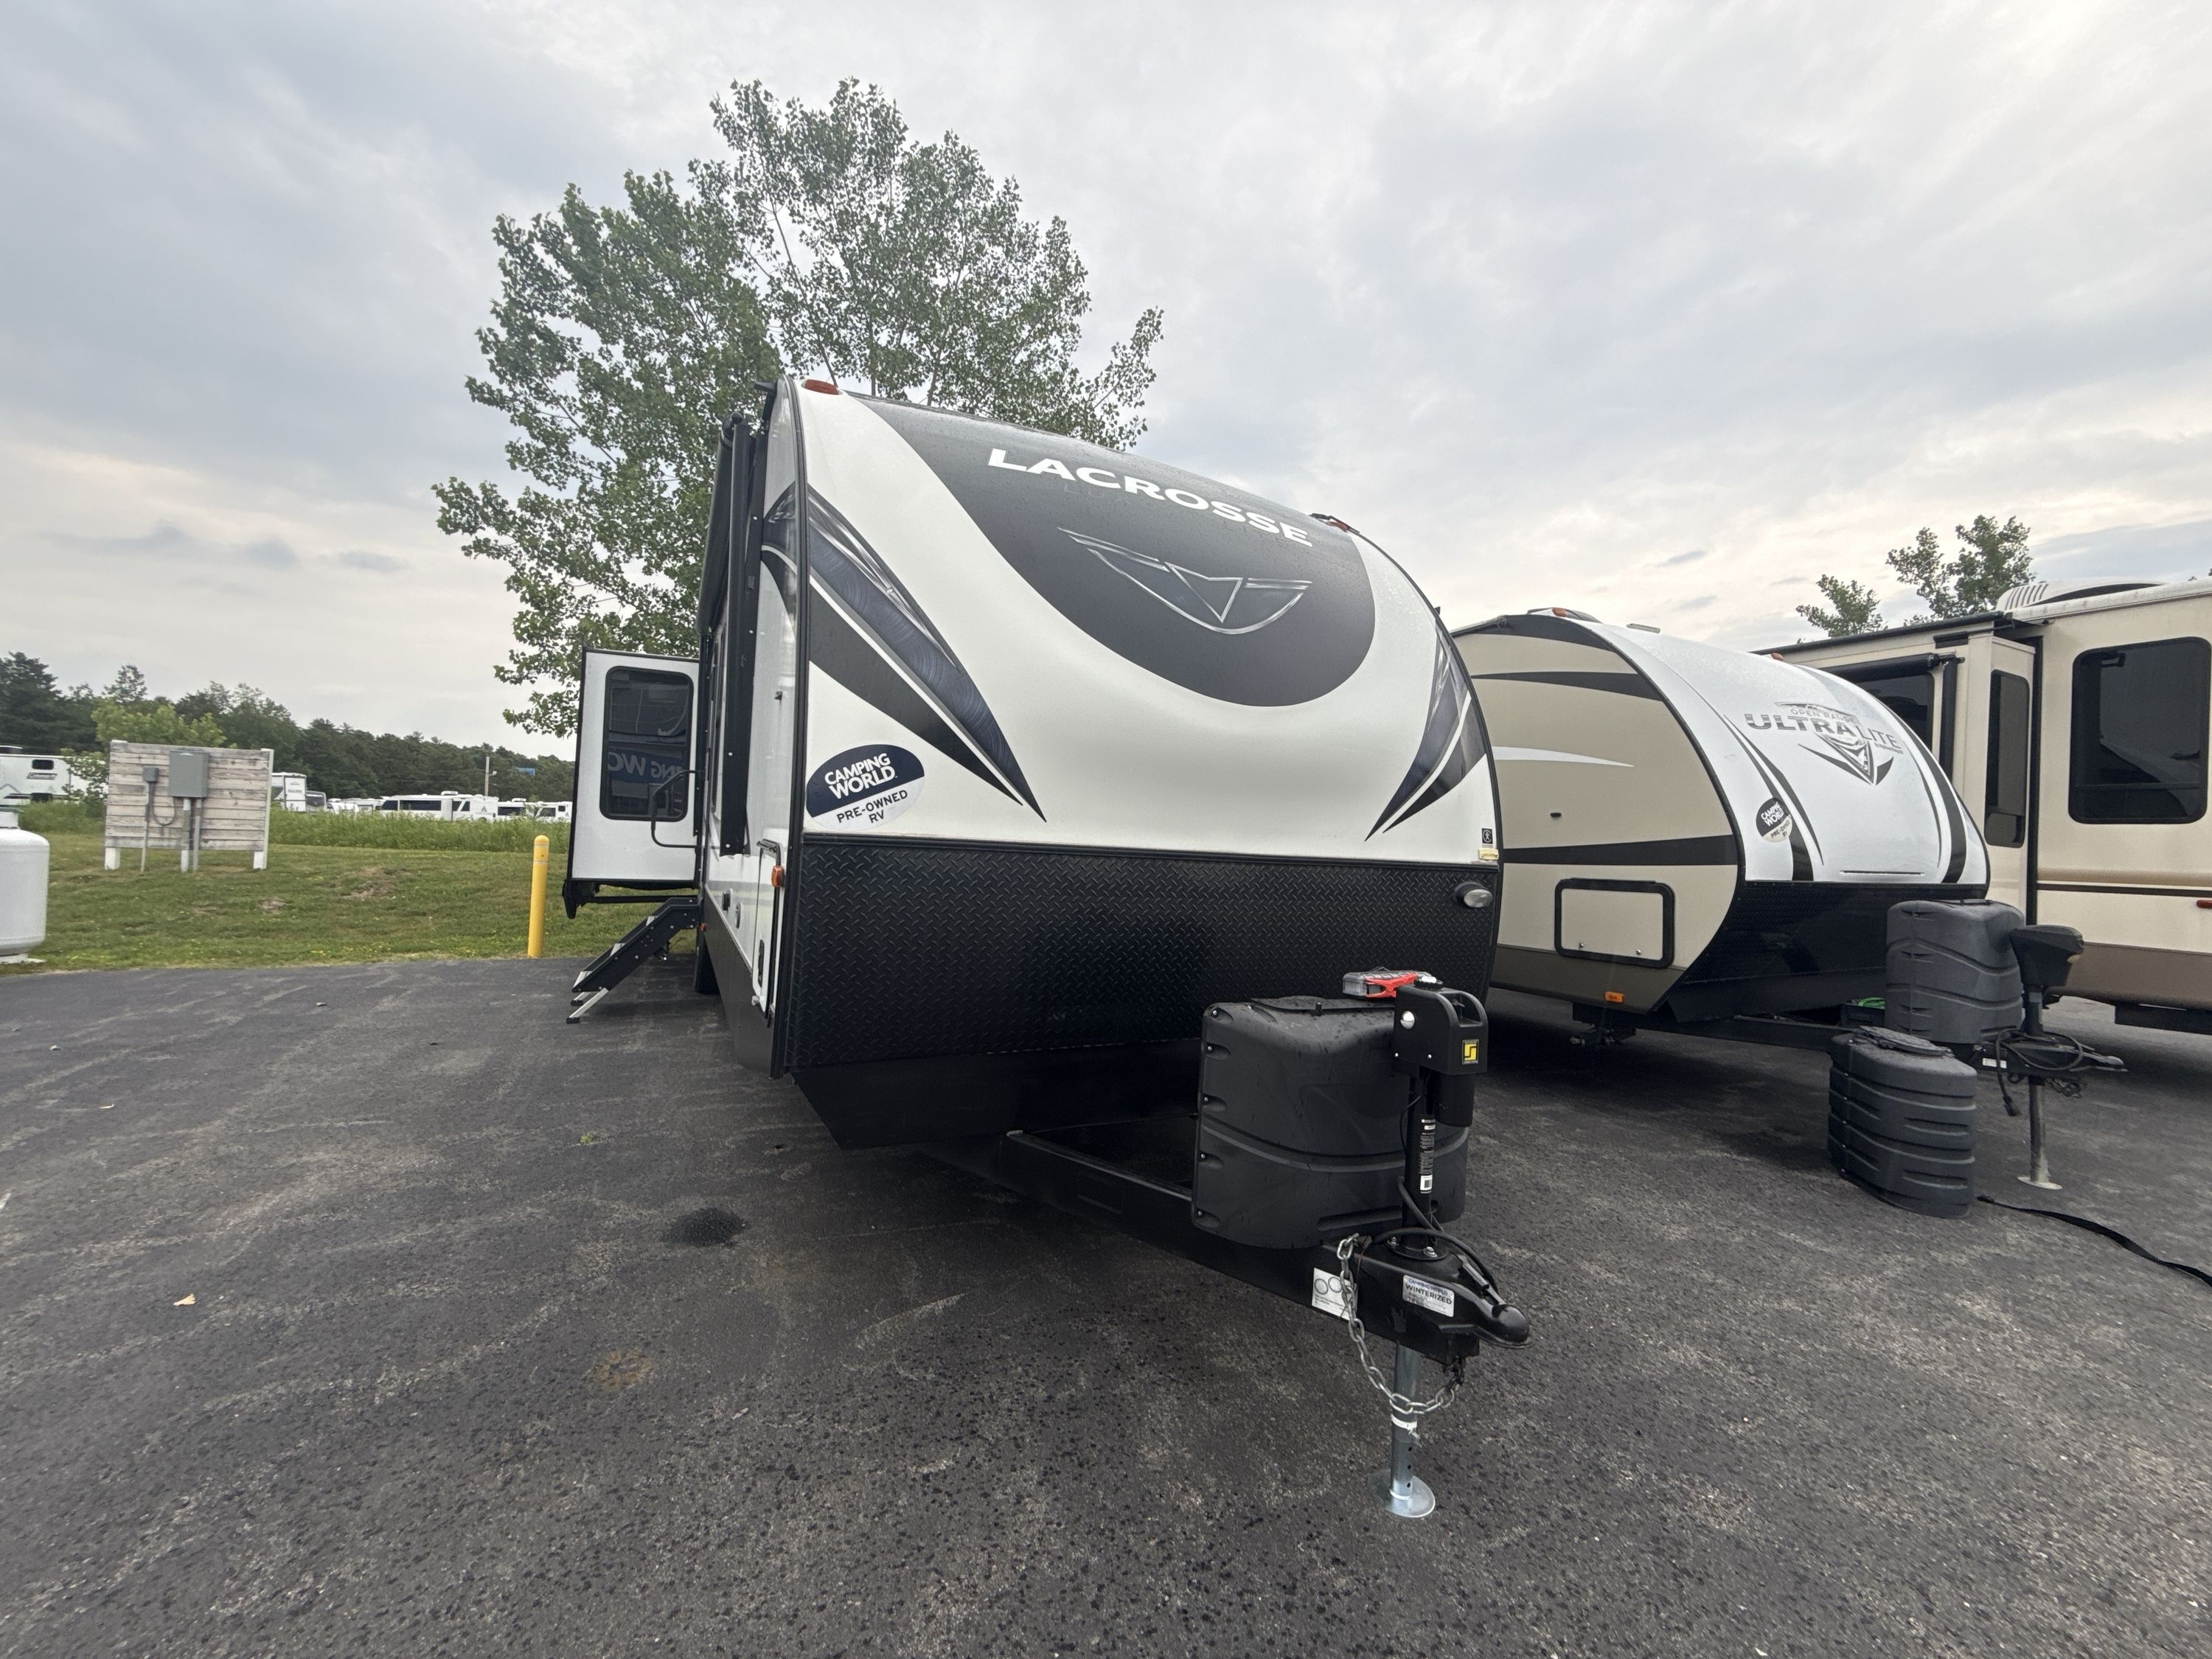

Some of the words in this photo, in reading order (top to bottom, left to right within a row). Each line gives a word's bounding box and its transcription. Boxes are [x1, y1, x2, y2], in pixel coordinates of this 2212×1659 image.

[987, 448, 1313, 547] LACROSSE
[824, 753, 891, 785] CAMPING
[828, 765, 896, 799] WORLD
[836, 790, 908, 823] PRE-OWNED
[869, 810, 885, 823] RV
[1761, 801, 1781, 820] CAMPG
[1770, 819, 1790, 838] PRE-OD
[1405, 1283, 1453, 1304] WINTERIZED
